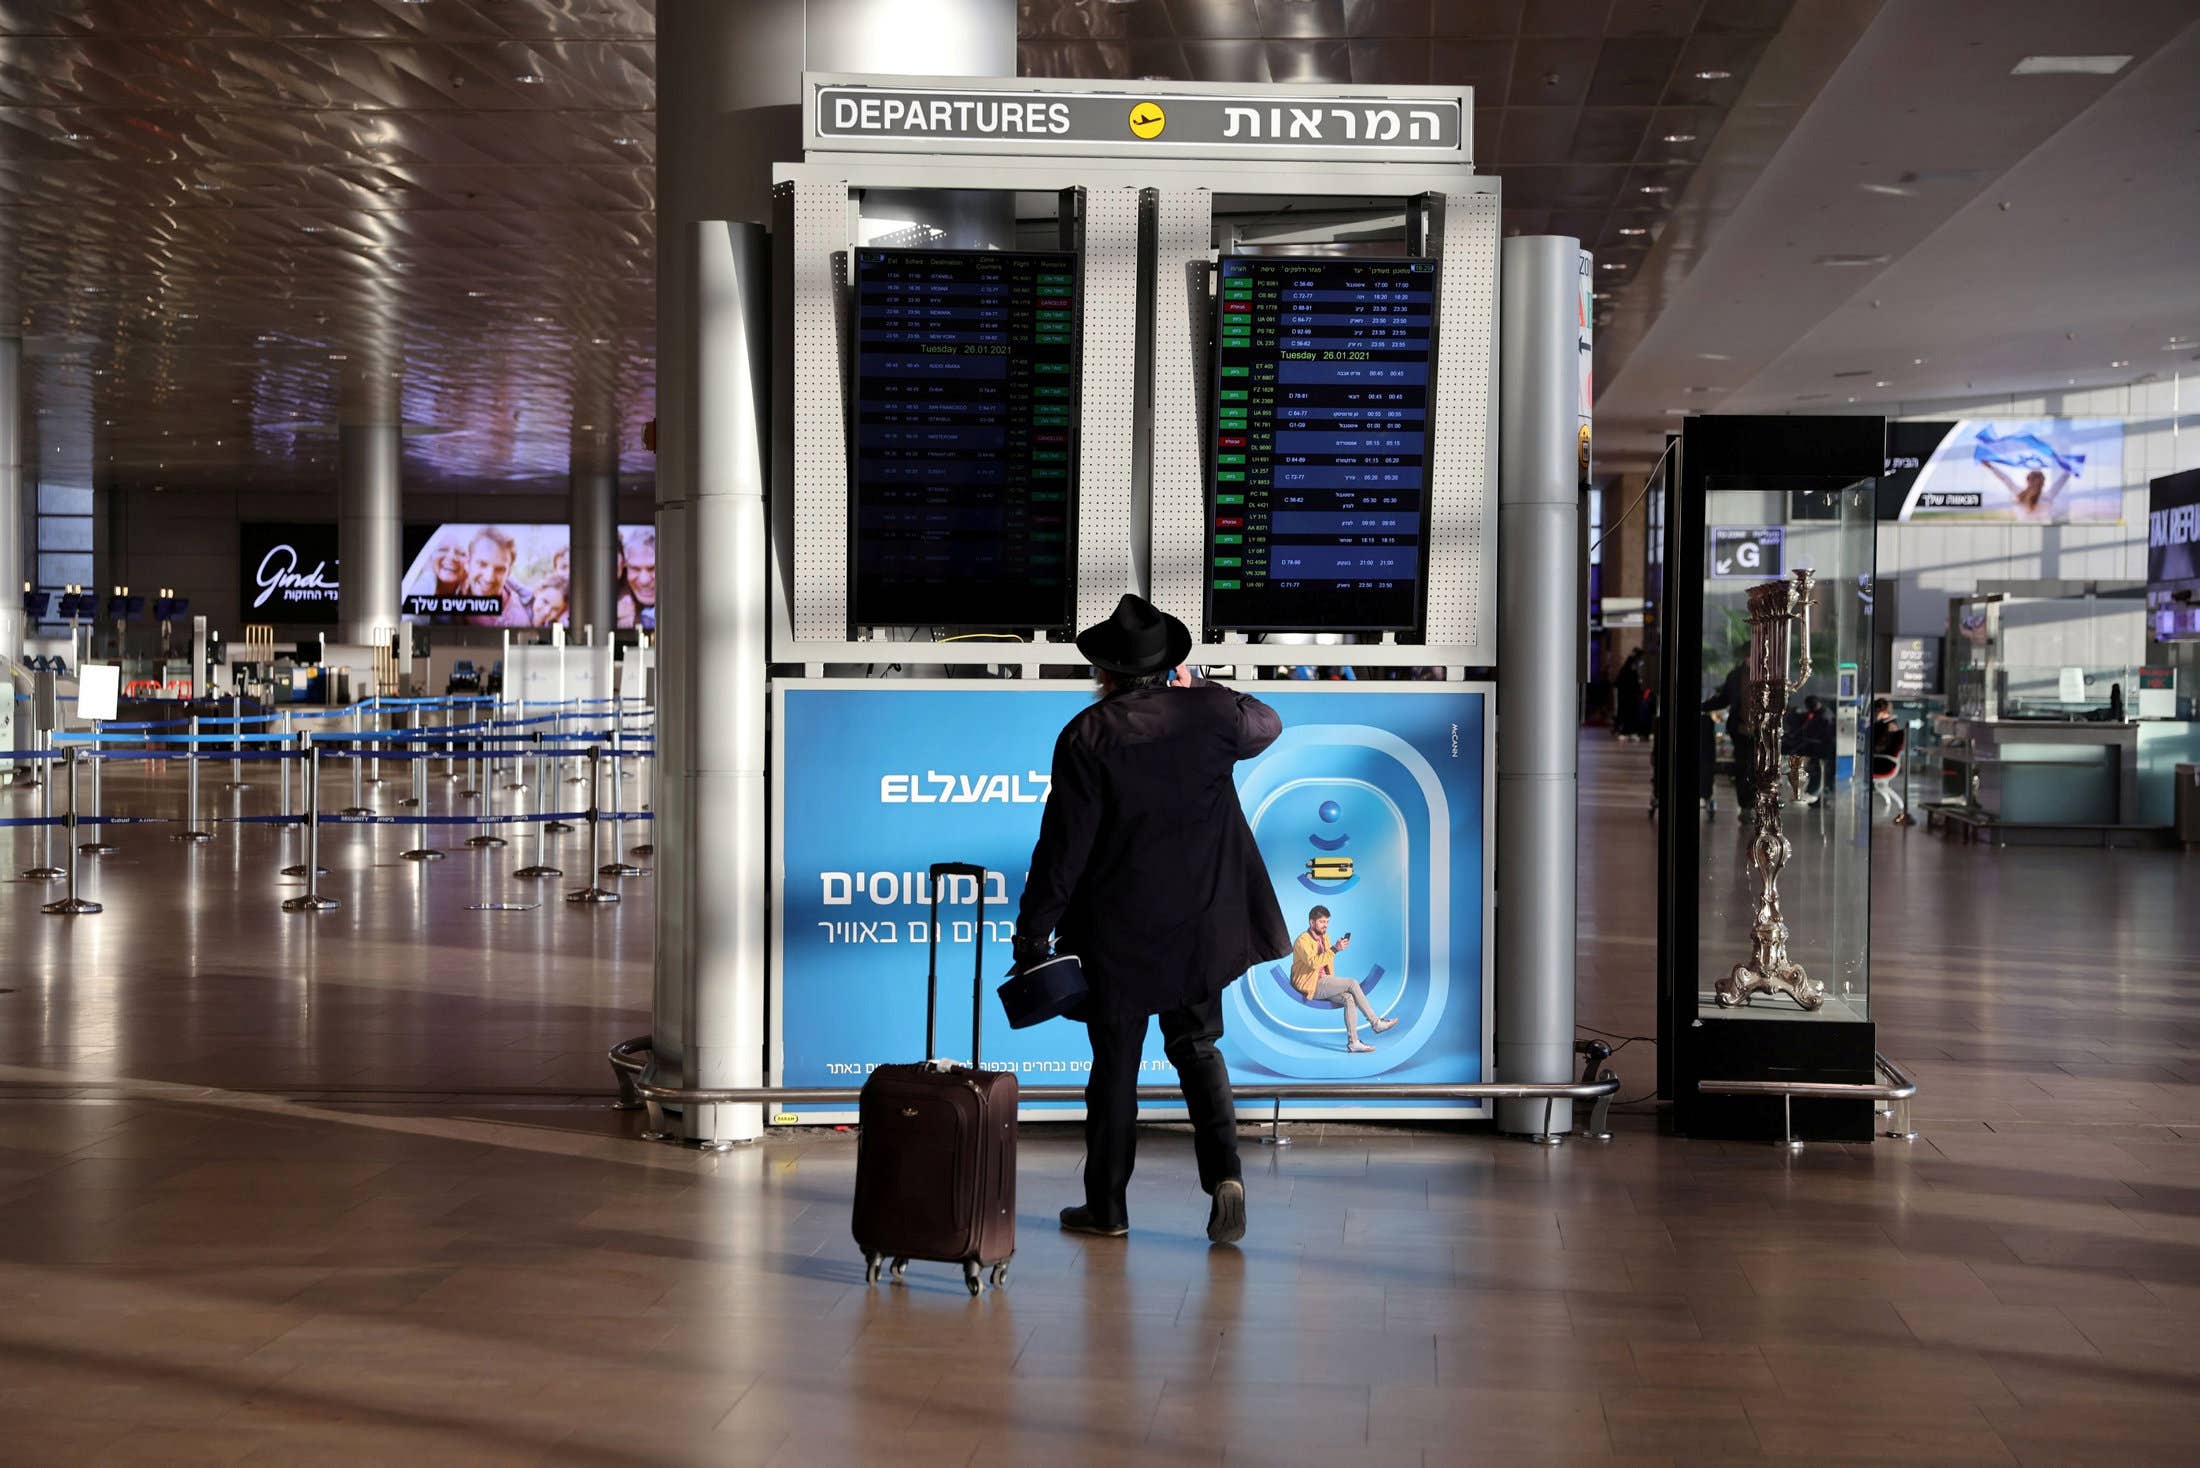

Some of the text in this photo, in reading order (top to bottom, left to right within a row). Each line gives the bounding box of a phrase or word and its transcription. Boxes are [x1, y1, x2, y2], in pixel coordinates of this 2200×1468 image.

[834, 98, 1070, 134] DEPARTURES
[1223, 107, 1440, 141] המראות
[921, 344, 1011, 354] Tuesday 26.01.2021
[1281, 351, 1316, 361] Tuesday
[2150, 501, 2200, 548] TAX REFU
[1736, 542, 1760, 568] G
[283, 590, 339, 602] נדי החזקות
[410, 596, 499, 614] השורשים שלך
[1451, 723, 1459, 758] McCANN
[820, 872, 1008, 905] במטוסים
[818, 920, 898, 944] באוויר
[952, 920, 1016, 943] ברים
[826, 1063, 861, 1074] באתר
[1022, 1062, 1065, 1072] נבחרים
